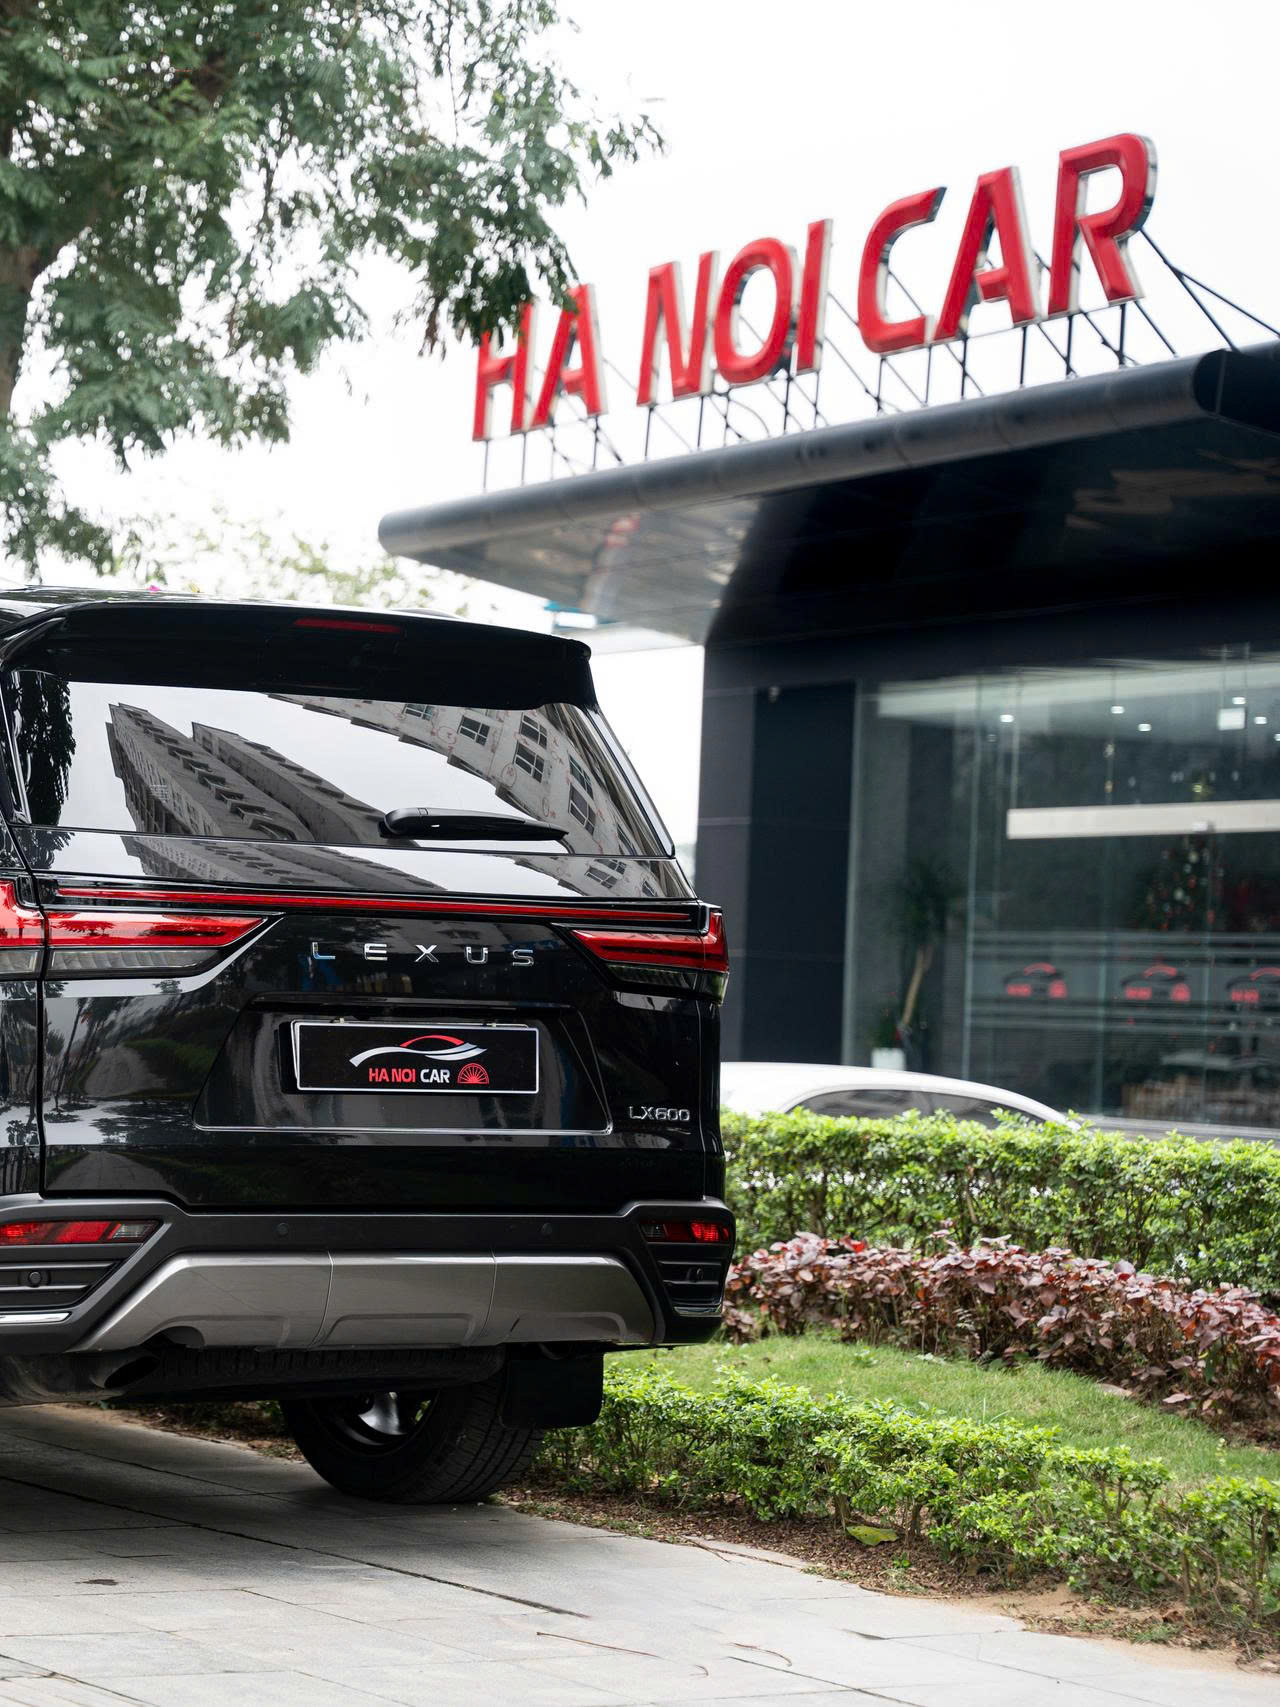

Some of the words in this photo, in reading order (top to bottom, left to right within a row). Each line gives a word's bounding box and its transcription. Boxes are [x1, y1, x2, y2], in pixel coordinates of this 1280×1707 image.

[472, 284, 608, 442] HA
[636, 218, 833, 408] NOI
[857, 132, 1158, 354] CAR
[312, 941, 535, 967] LEXUS
[368, 1067, 391, 1083] HA
[391, 1068, 416, 1084] NOI
[420, 1068, 451, 1084] CAR
